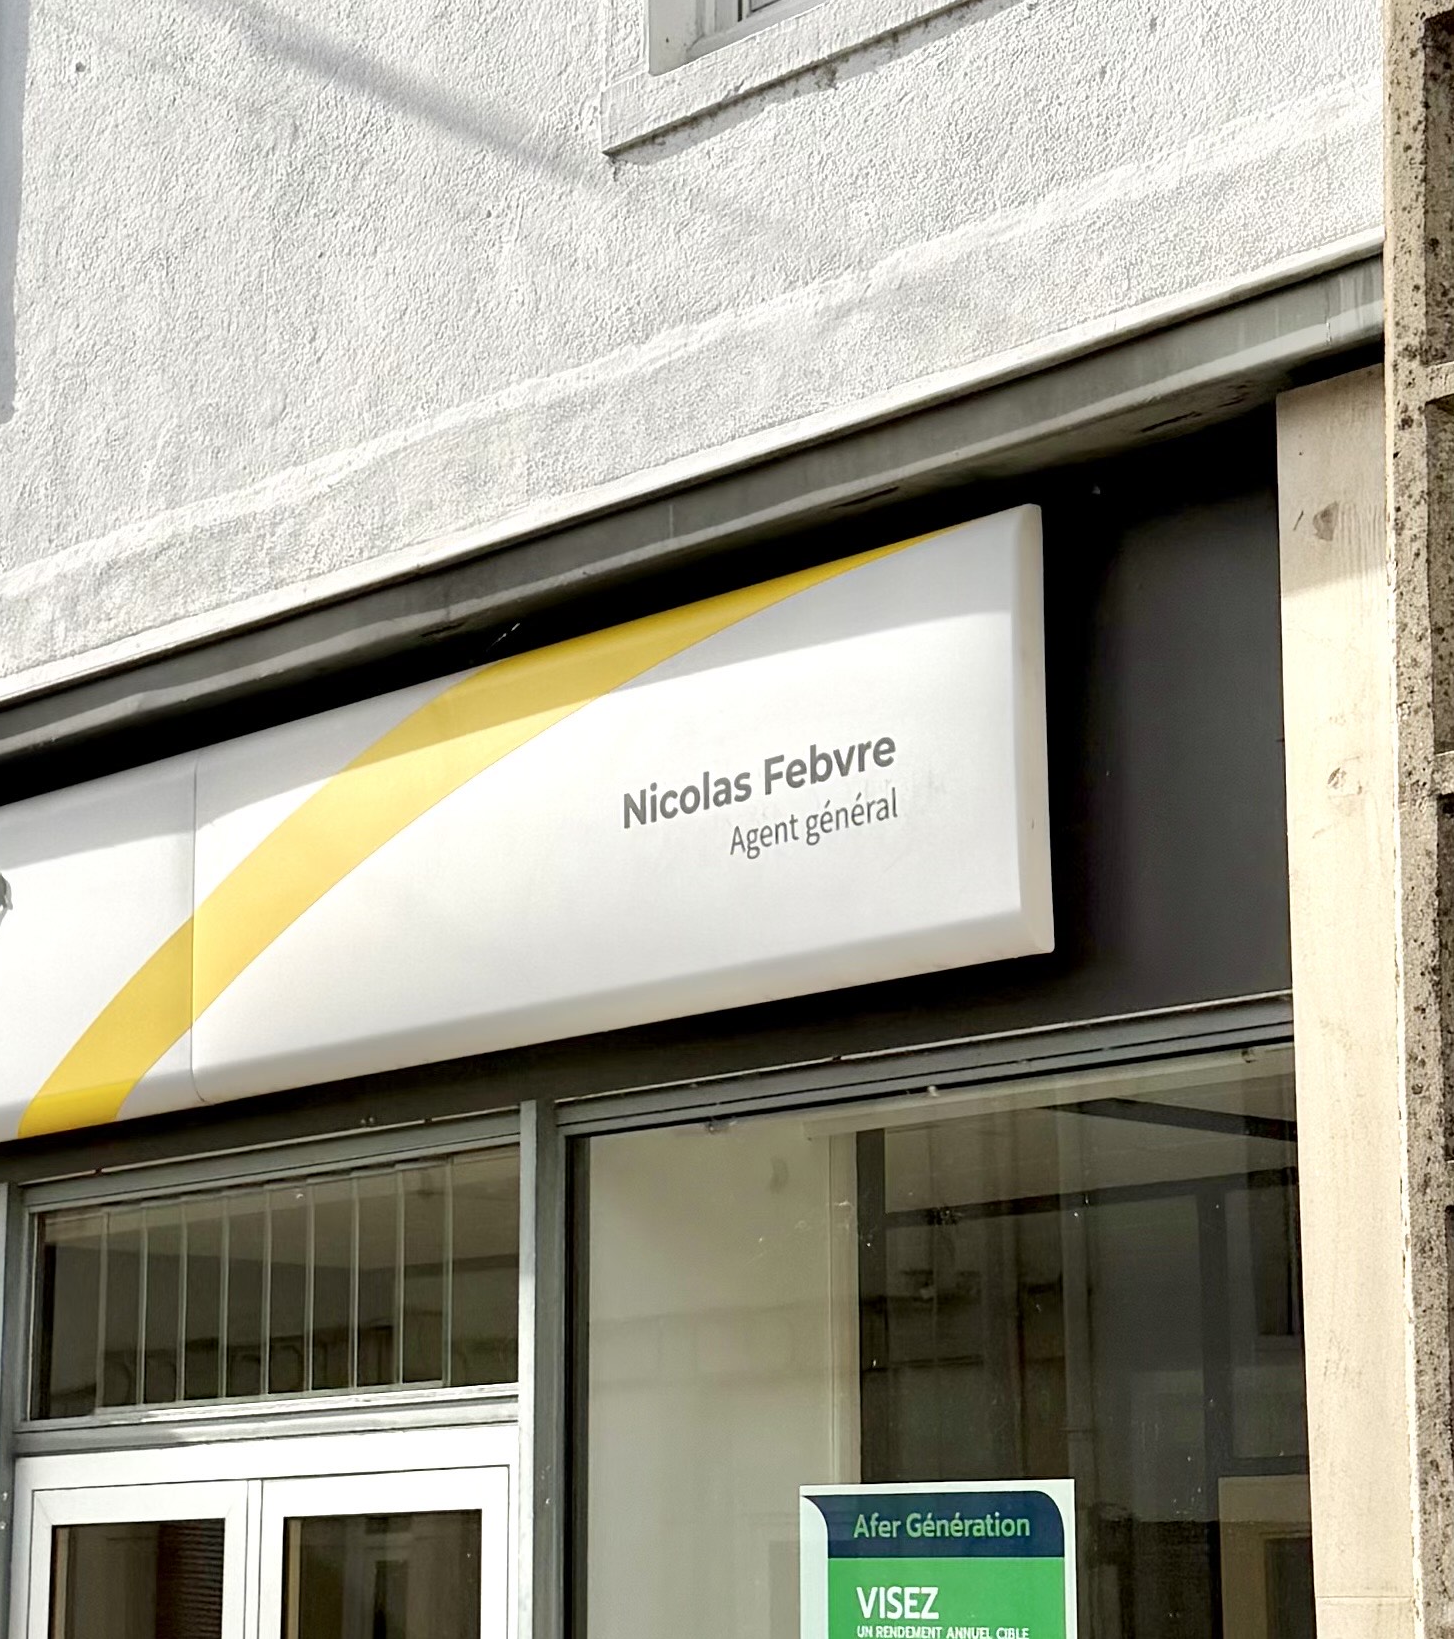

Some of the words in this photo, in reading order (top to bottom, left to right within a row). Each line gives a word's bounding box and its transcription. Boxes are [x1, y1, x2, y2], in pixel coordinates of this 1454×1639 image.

[623, 770, 752, 830] Nicolas
[764, 736, 896, 796] Febvre
[730, 814, 799, 860] Agent
[806, 787, 898, 846] général
[853, 1512, 902, 1539] Afer
[906, 1512, 1031, 1538] Génération
[856, 1585, 940, 1620] VISEZ
[857, 1625, 872, 1638] UN
[875, 1625, 943, 1639] RENDEMENT
